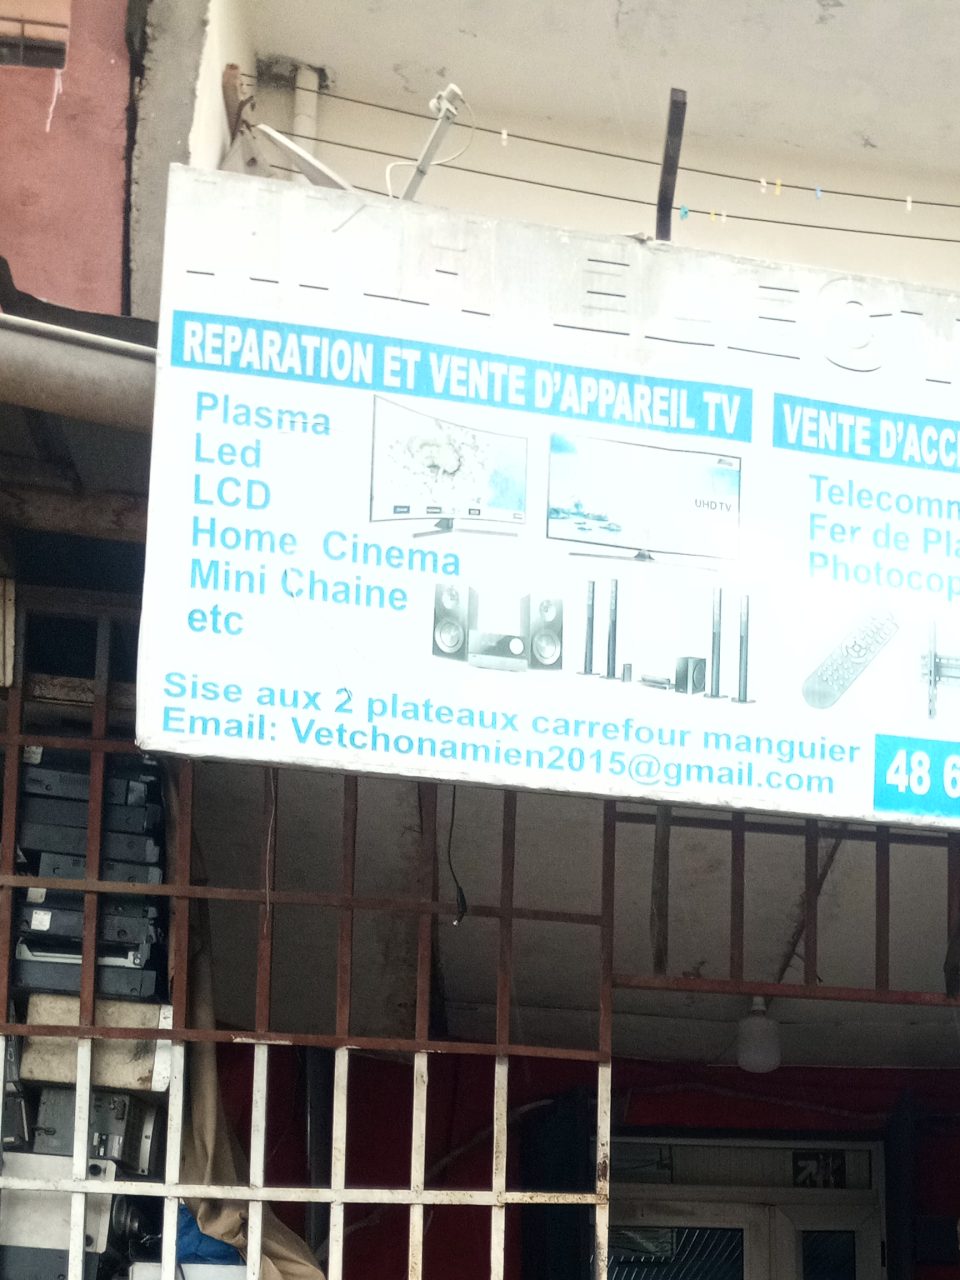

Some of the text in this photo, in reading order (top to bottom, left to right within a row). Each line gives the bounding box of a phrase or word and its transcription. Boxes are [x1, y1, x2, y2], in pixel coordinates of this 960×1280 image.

[184, 321, 740, 433] REPARATION ET VENTE D'APPAREIL TV
[196, 391, 331, 436] Plasma
[784, 404, 870, 455] VENTE
[195, 432, 261, 468] Led
[193, 474, 271, 511] LCD
[192, 516, 460, 576] Home Cinema
[810, 512, 861, 543] Fer
[873, 523, 909, 551] de
[190, 558, 408, 611] Mini Chaine
[187, 604, 243, 636] etc
[163, 672, 861, 764] Sise aux 2 plateaux carrefour manguier
[162, 705, 834, 794] Email: Vetchonamien2015@gmail.com
[887, 750, 930, 794] 48
